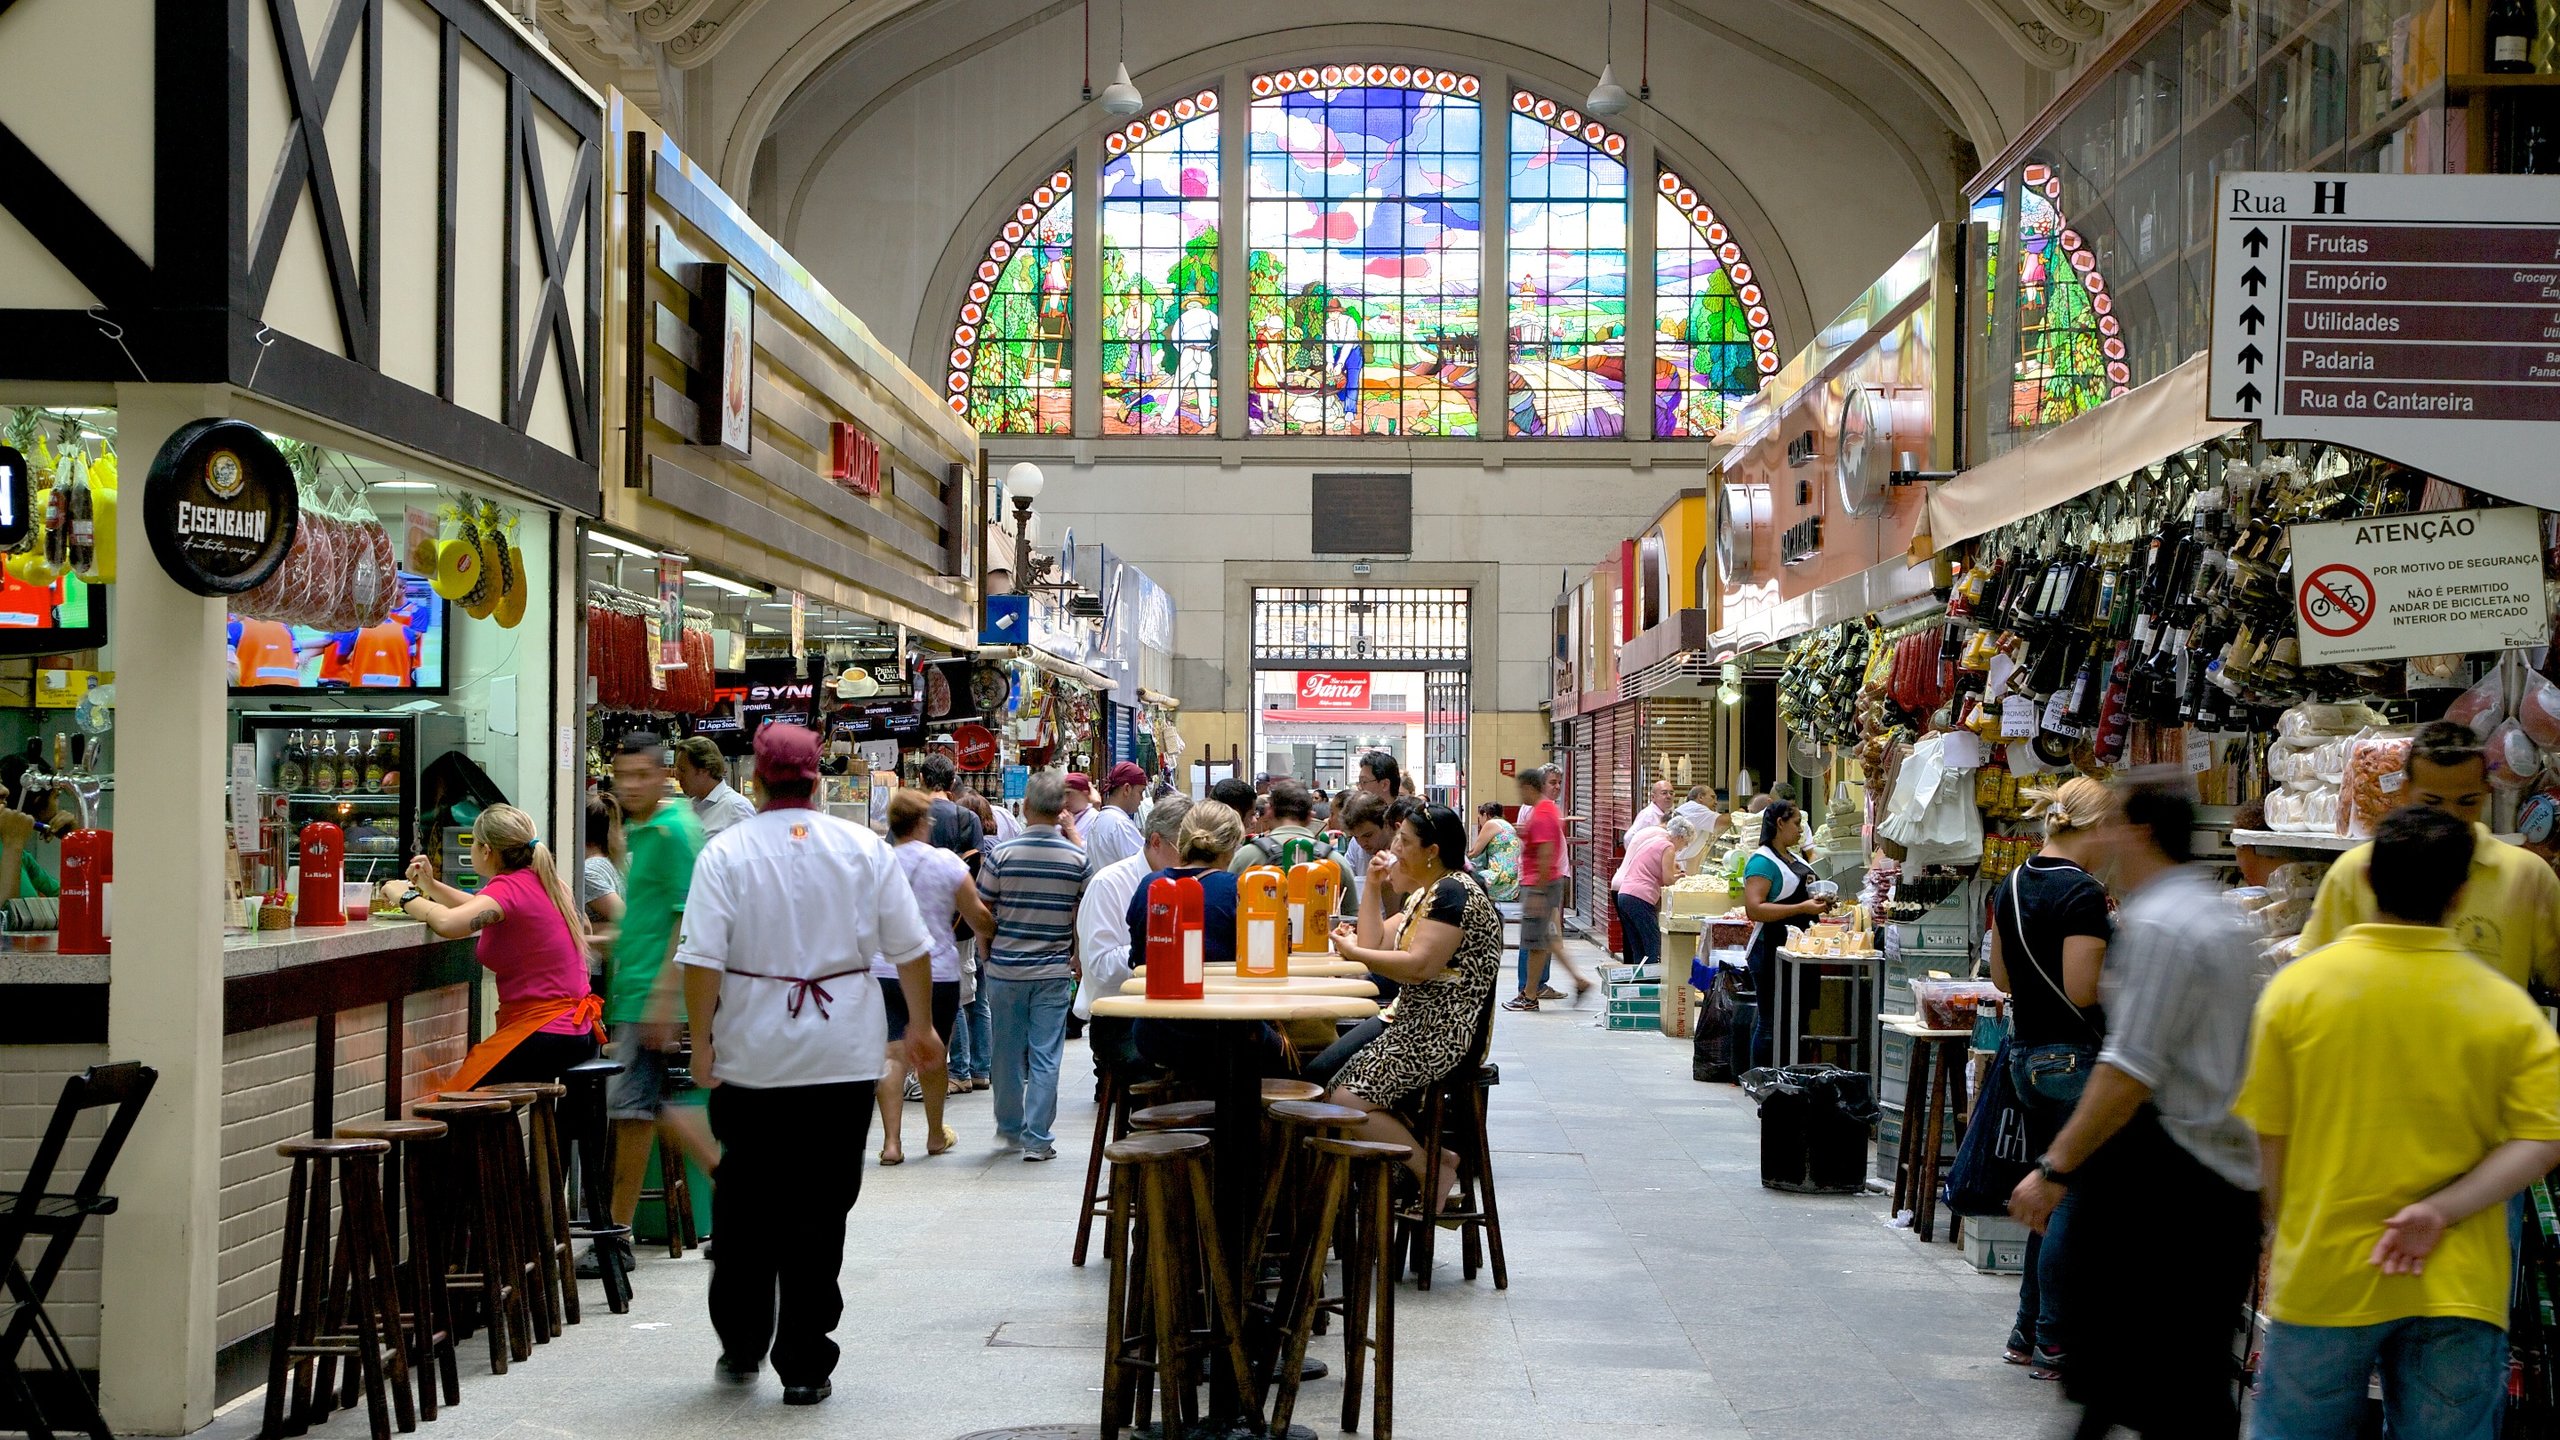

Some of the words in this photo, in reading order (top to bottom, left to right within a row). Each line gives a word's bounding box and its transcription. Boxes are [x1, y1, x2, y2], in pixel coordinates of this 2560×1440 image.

[2231, 188, 2287, 214] Rua
[2312, 181, 2348, 214] H
[2306, 234, 2368, 254] Frutas
[2305, 270, 2388, 294] Empório
[2513, 272, 2557, 285] Grocery
[2303, 311, 2400, 332] Utilidades
[2302, 350, 2375, 370] Padaria
[2300, 390, 2337, 409] Rua
[2344, 391, 2367, 409] da
[2373, 391, 2474, 412] Cantareira
[2355, 515, 2475, 545] ATENÇÃO
[2373, 565, 2398, 576] POR
[2401, 562, 2446, 574] MOTIVO
[2448, 560, 2464, 570] DE
[2467, 554, 2539, 570] SEGURANÇA
[2408, 586, 2432, 599] NÃO
[2436, 584, 2444, 597] É
[2446, 582, 2509, 596] PERMITIDO
[2389, 601, 2431, 613] ANDAR
[2432, 600, 2449, 610] DE
[2452, 596, 2510, 609] BICICLETA
[2512, 593, 2530, 604] NO
[2393, 613, 2447, 626] INTERIOR
[2450, 611, 2467, 622] DO
[2470, 606, 2528, 621] MERCADO
[1357, 640, 1365, 653] 6
[1301, 673, 1363, 698] Fama
